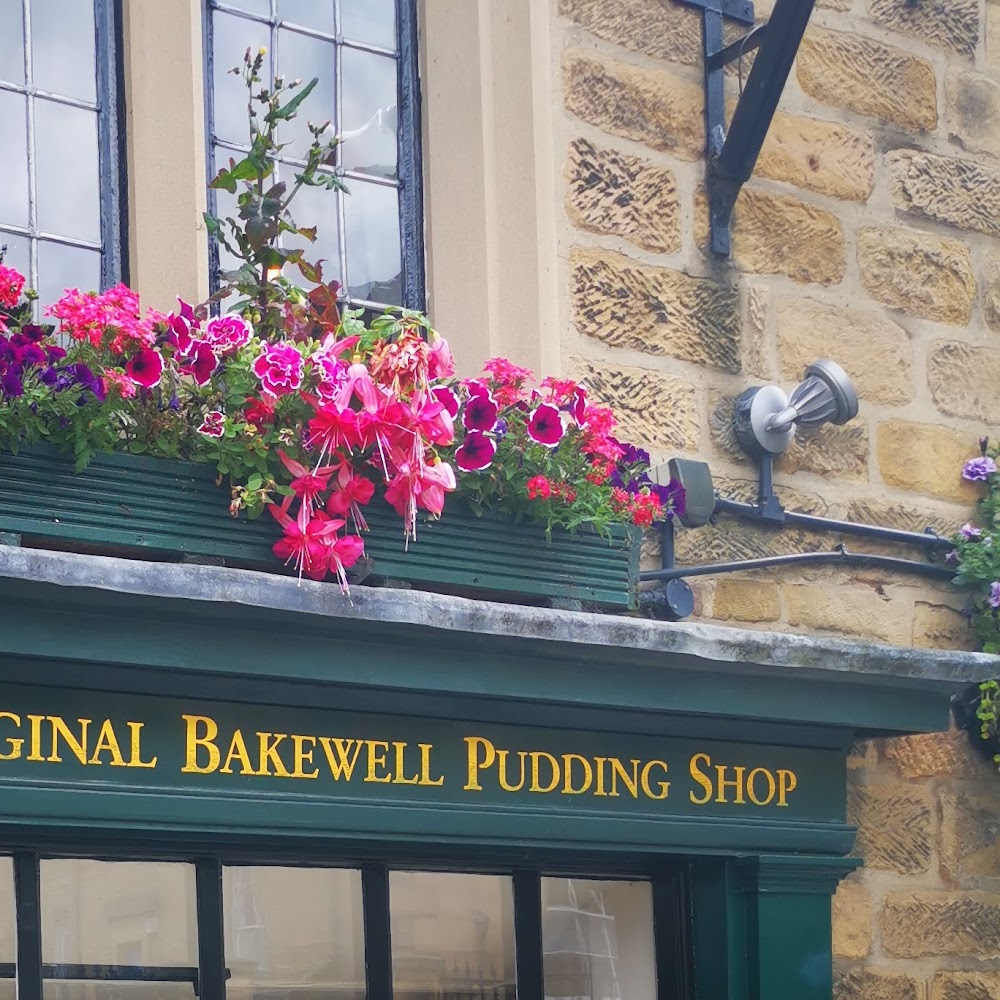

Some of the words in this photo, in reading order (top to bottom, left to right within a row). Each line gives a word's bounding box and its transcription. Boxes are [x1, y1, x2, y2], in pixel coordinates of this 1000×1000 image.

[181, 714, 445, 786] BAKEWELL
[463, 736, 671, 800] PUDDING
[689, 752, 797, 807] SHOP
